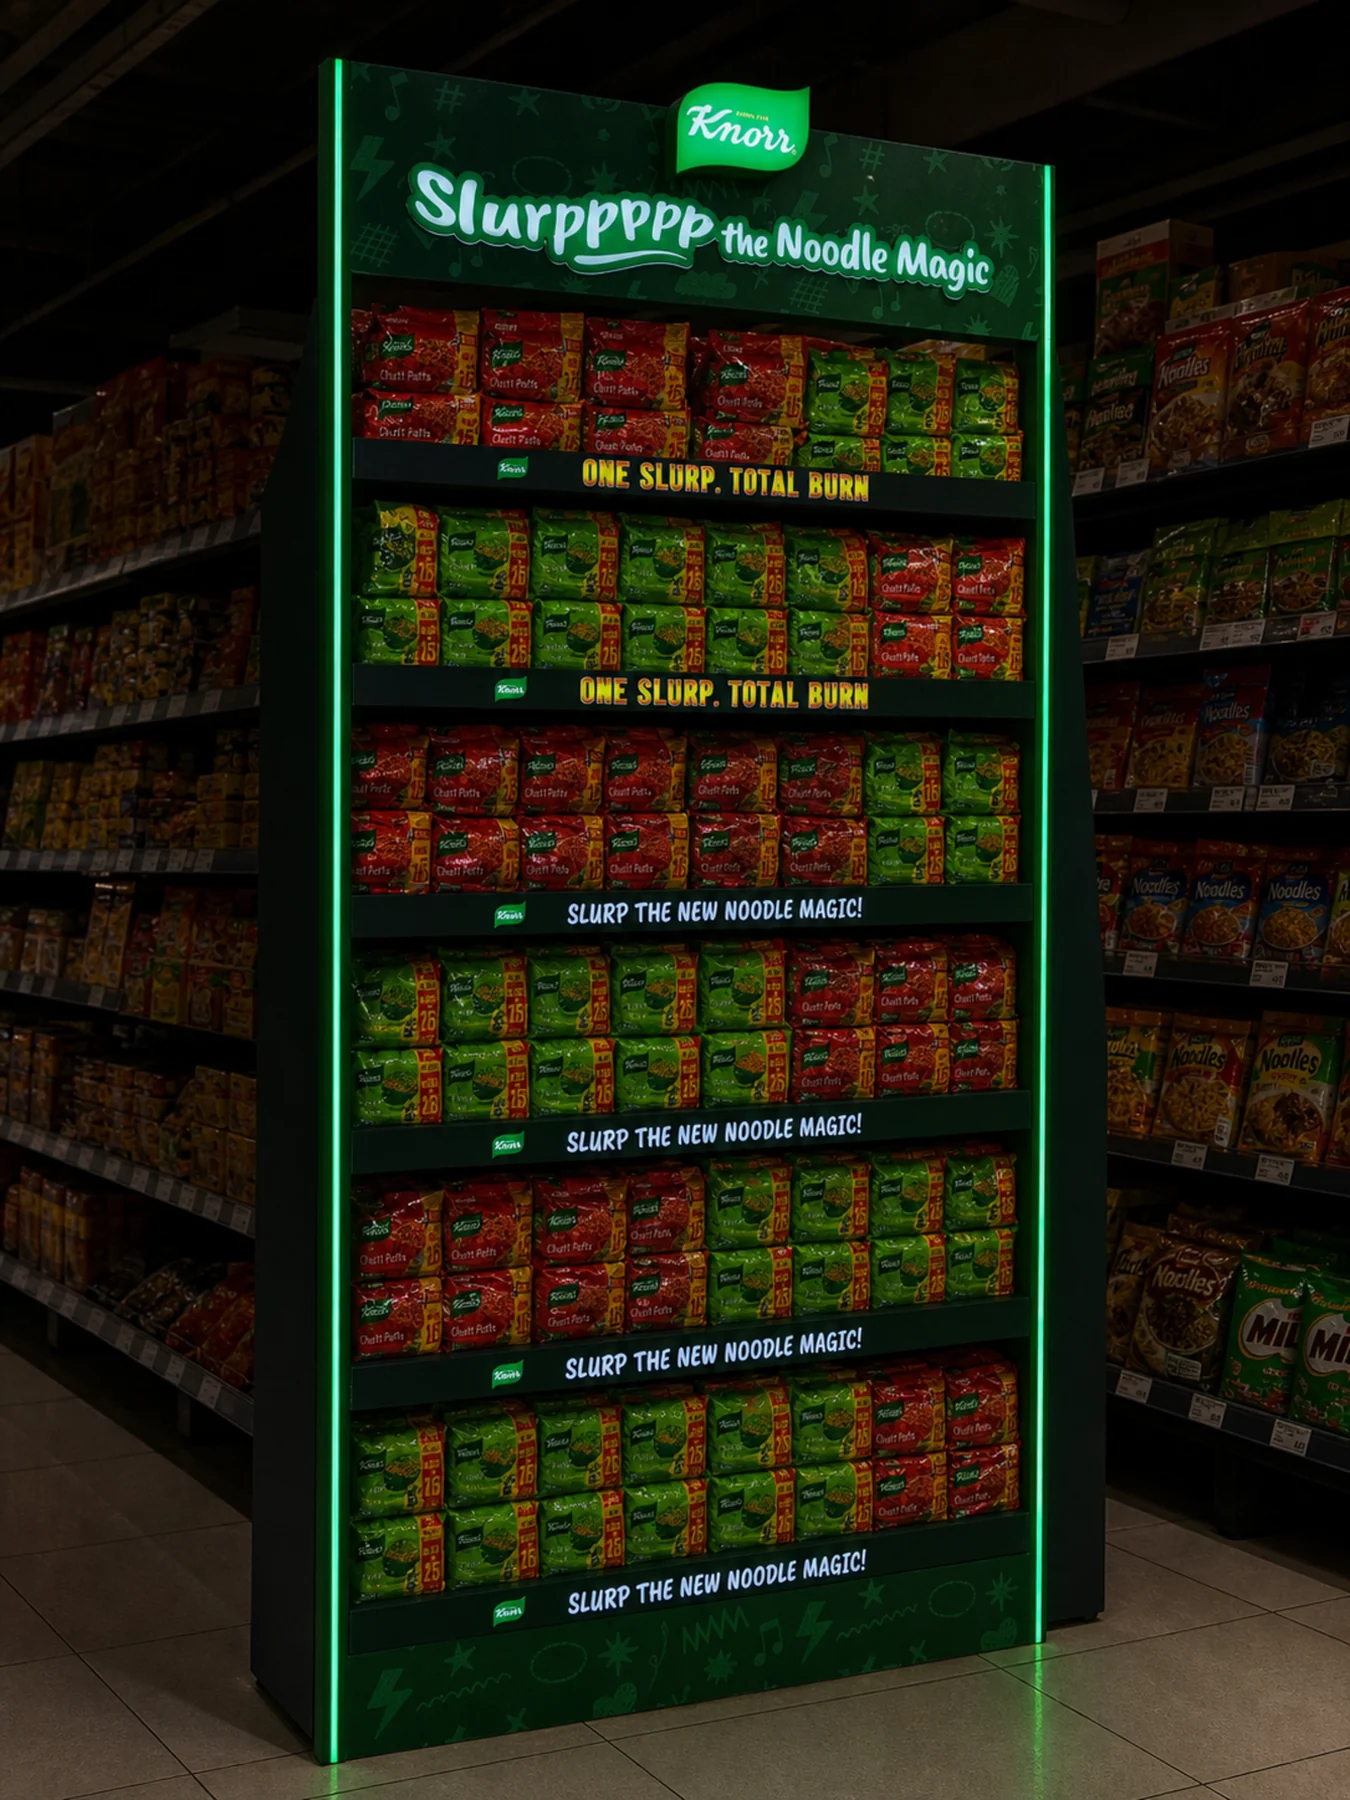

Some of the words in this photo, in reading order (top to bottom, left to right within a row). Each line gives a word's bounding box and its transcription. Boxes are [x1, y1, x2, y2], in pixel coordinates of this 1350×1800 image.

[686, 104, 796, 154] Knorr
[721, 222, 768, 258] the
[777, 222, 888, 273] Noodle
[897, 241, 989, 292] Magic
[582, 458, 630, 489] ONE
[638, 460, 722, 494] SLURP.
[729, 466, 799, 498] TOTAL
[808, 470, 870, 502] BURN
[580, 676, 628, 706] ONE
[636, 677, 721, 708] SLURP.
[727, 679, 799, 709] TOTAL
[807, 681, 869, 710] BURN
[567, 902, 629, 925] SLURP
[634, 901, 672, 923] THE
[678, 900, 718, 922] NEW
[724, 899, 793, 921] NOODLE
[799, 896, 863, 919] MAGIC!
[1268, 882, 1322, 901] Noodles
[1171, 1045, 1226, 1069] Noodles
[566, 1128, 629, 1153] SLURP
[634, 1125, 672, 1149] THE
[678, 1123, 718, 1146] NEW
[724, 1117, 794, 1142] NOODLE
[799, 1112, 862, 1137] MAGIC!
[1246, 1314, 1299, 1348] MIL
[565, 1352, 628, 1380] SLURP
[633, 1348, 671, 1372] THE
[677, 1343, 718, 1368] NEW
[724, 1335, 794, 1363] NOODLE
[799, 1326, 862, 1355] MAGIC!
[568, 1585, 631, 1615] SLURP
[635, 1578, 674, 1604] THE
[680, 1571, 721, 1598] NEW
[727, 1560, 797, 1591] NOODLE
[803, 1548, 867, 1579] MAGIC!
